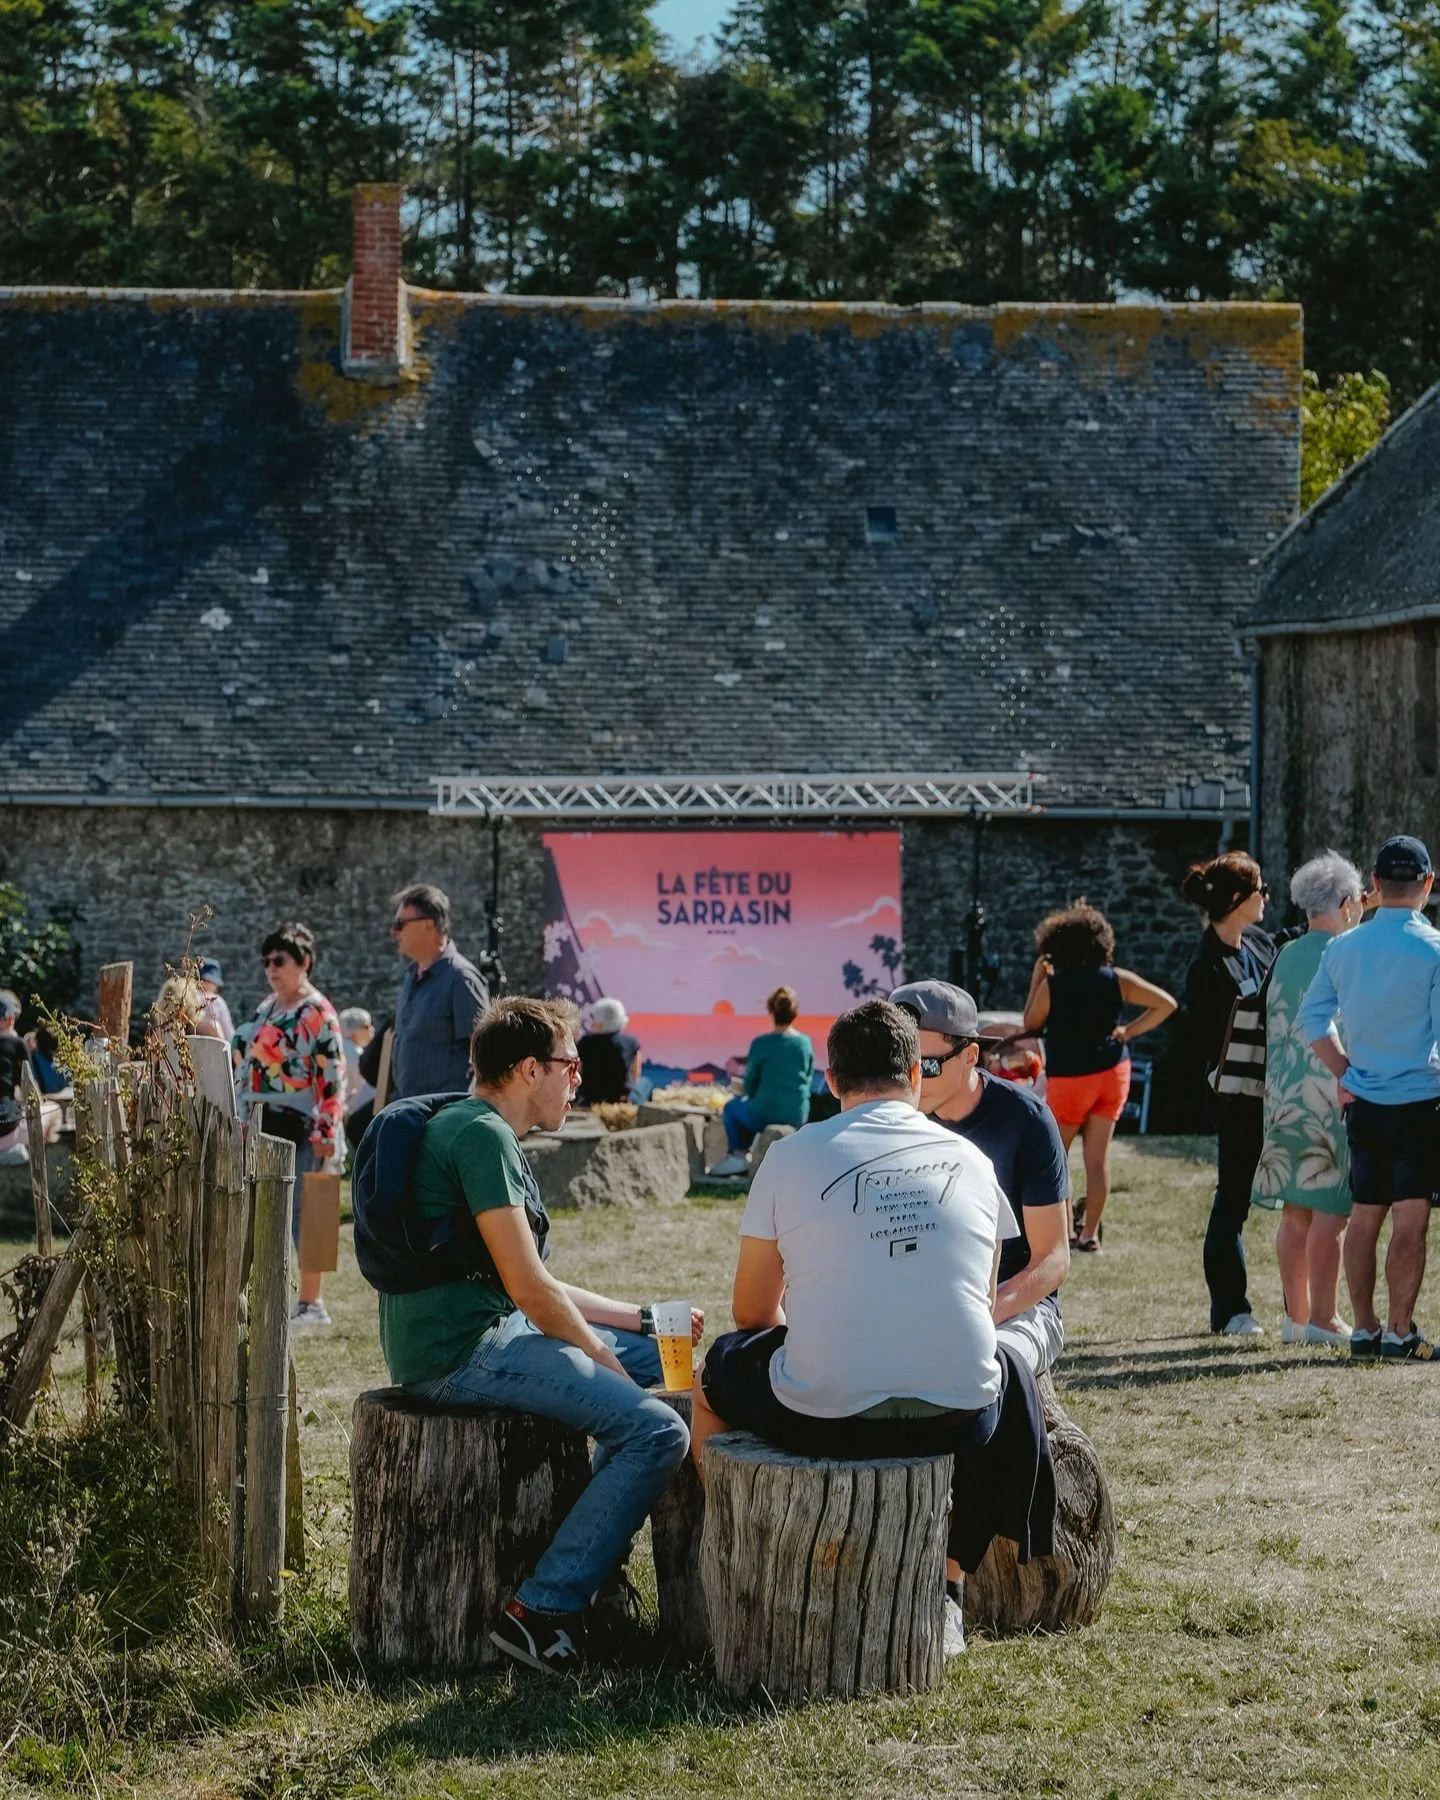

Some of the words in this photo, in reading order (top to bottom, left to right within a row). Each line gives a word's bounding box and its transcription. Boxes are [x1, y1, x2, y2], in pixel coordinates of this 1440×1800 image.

[657, 872, 687, 895] LA
[694, 865, 751, 895] FÊTE
[758, 872, 792, 895] DU
[657, 900, 792, 925] SARRASIN
[880, 1190, 928, 1201] LONDON
[875, 1204, 900, 1214] NEW
[902, 1200, 931, 1210] YORK
[889, 1213, 919, 1223] PARIS
